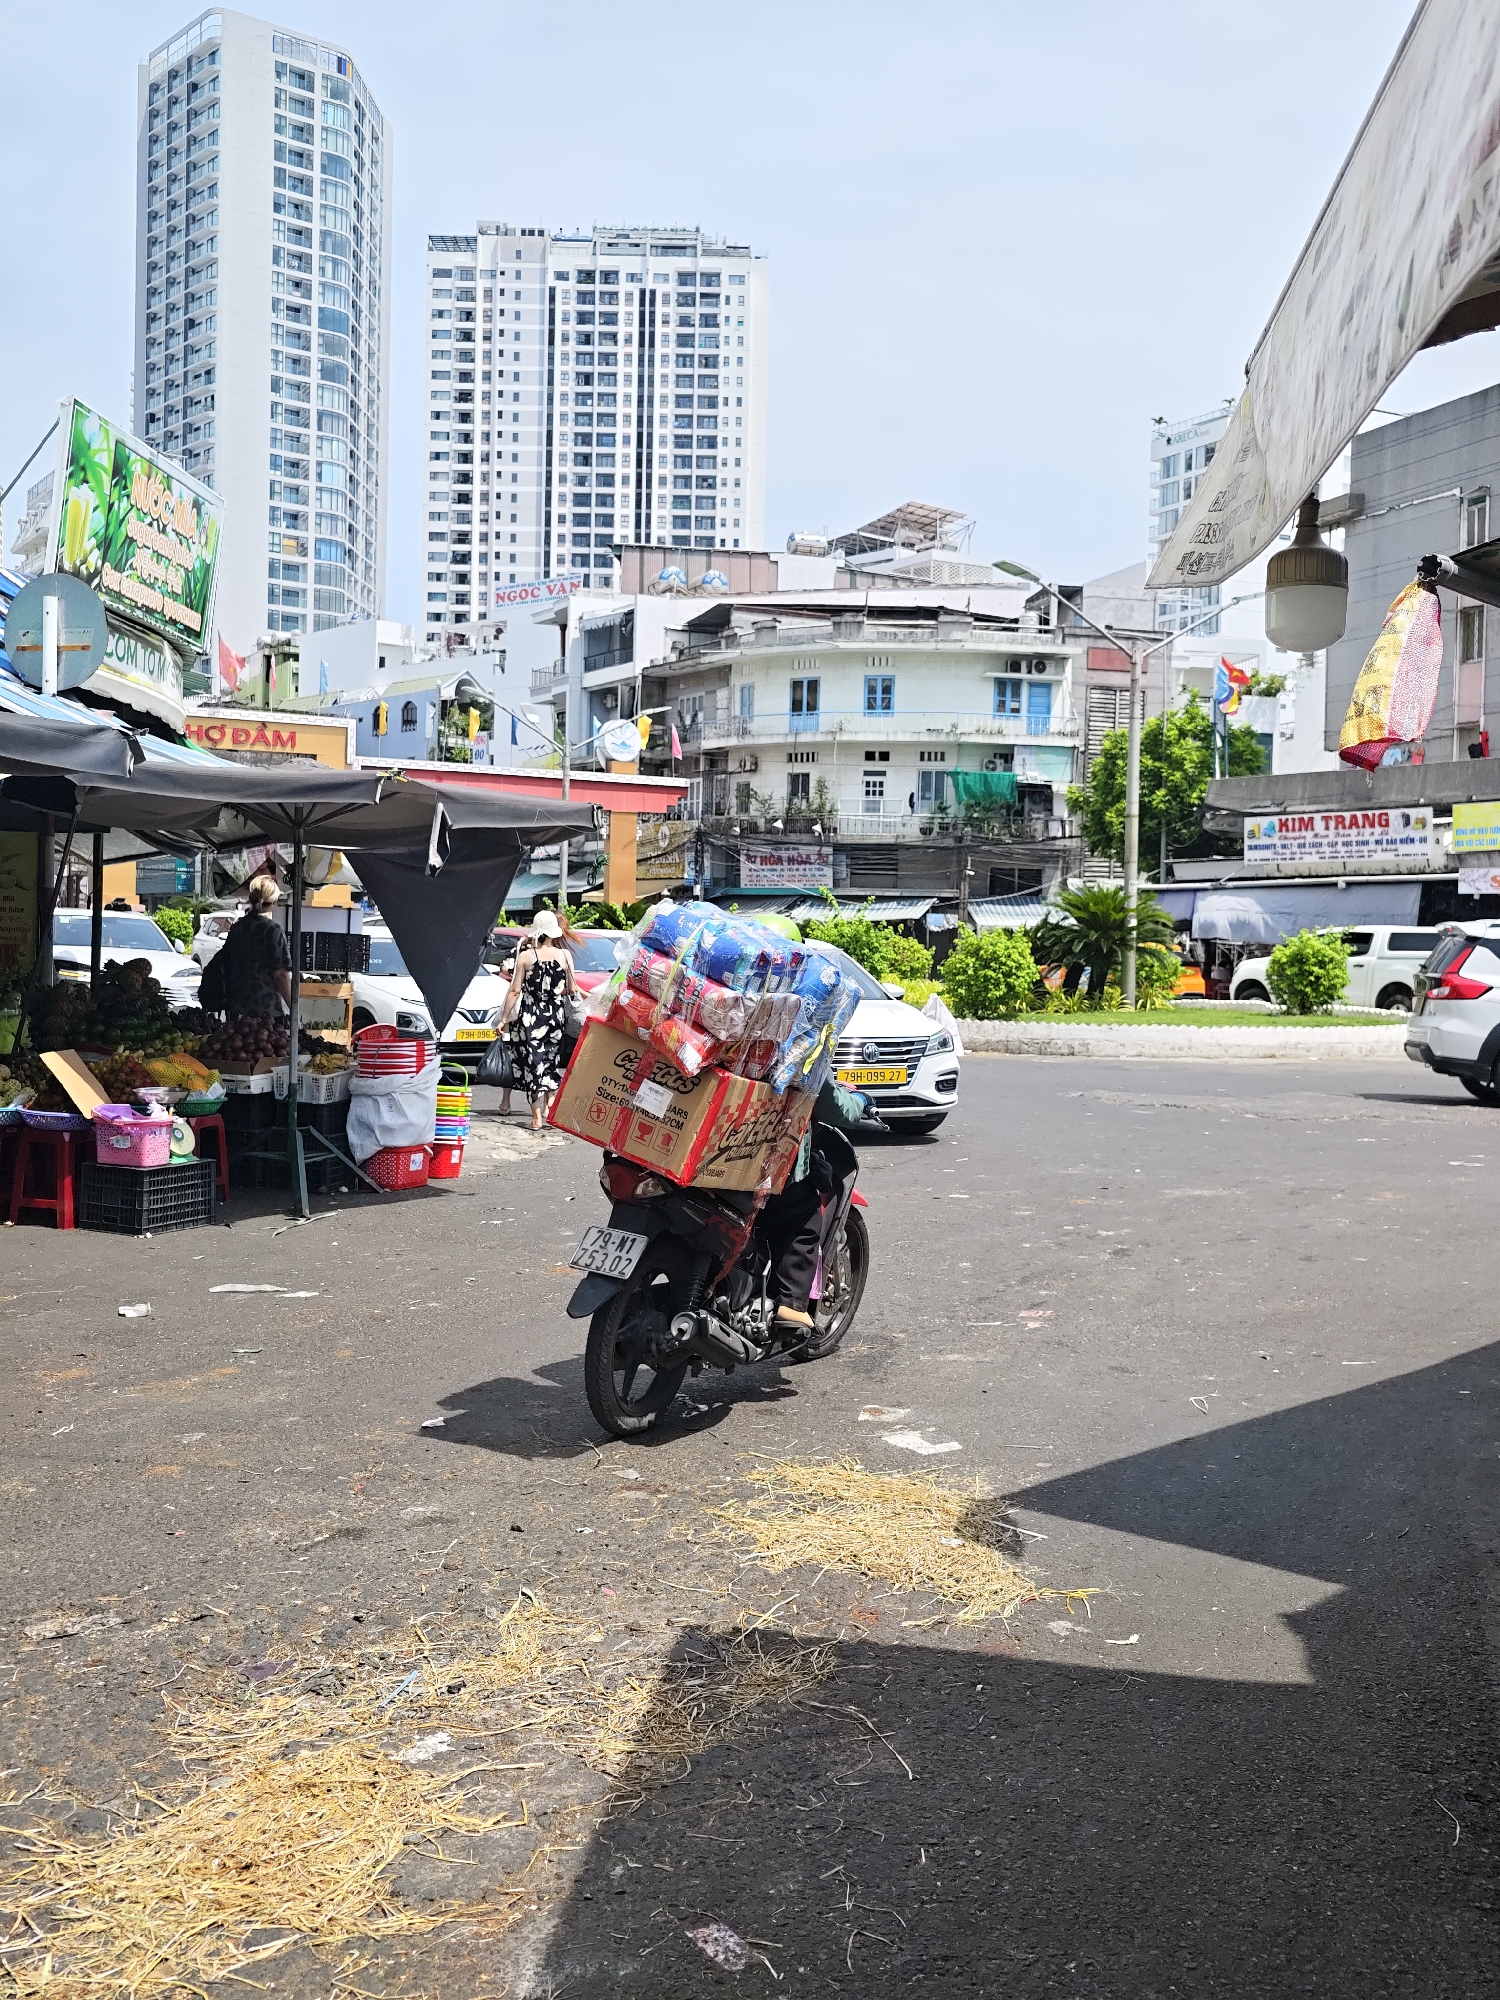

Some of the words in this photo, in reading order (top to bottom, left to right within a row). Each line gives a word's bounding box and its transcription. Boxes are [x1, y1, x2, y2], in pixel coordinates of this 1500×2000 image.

[131, 471, 173, 526] NƯỚC
[172, 494, 198, 543] MÍA
[186, 723, 227, 747] HỢ
[232, 721, 297, 749] ĐẦM
[1277, 816, 1315, 833] KIM
[1321, 811, 1390, 831] TRANG
[1355, 838, 1370, 847] SINH
[460, 1030, 498, 1039] 79H-096.5
[613, 1048, 702, 1095] CaEGGS
[843, 1070, 901, 1082] 79H-099.27
[589, 1229, 638, 1255] 79-N1
